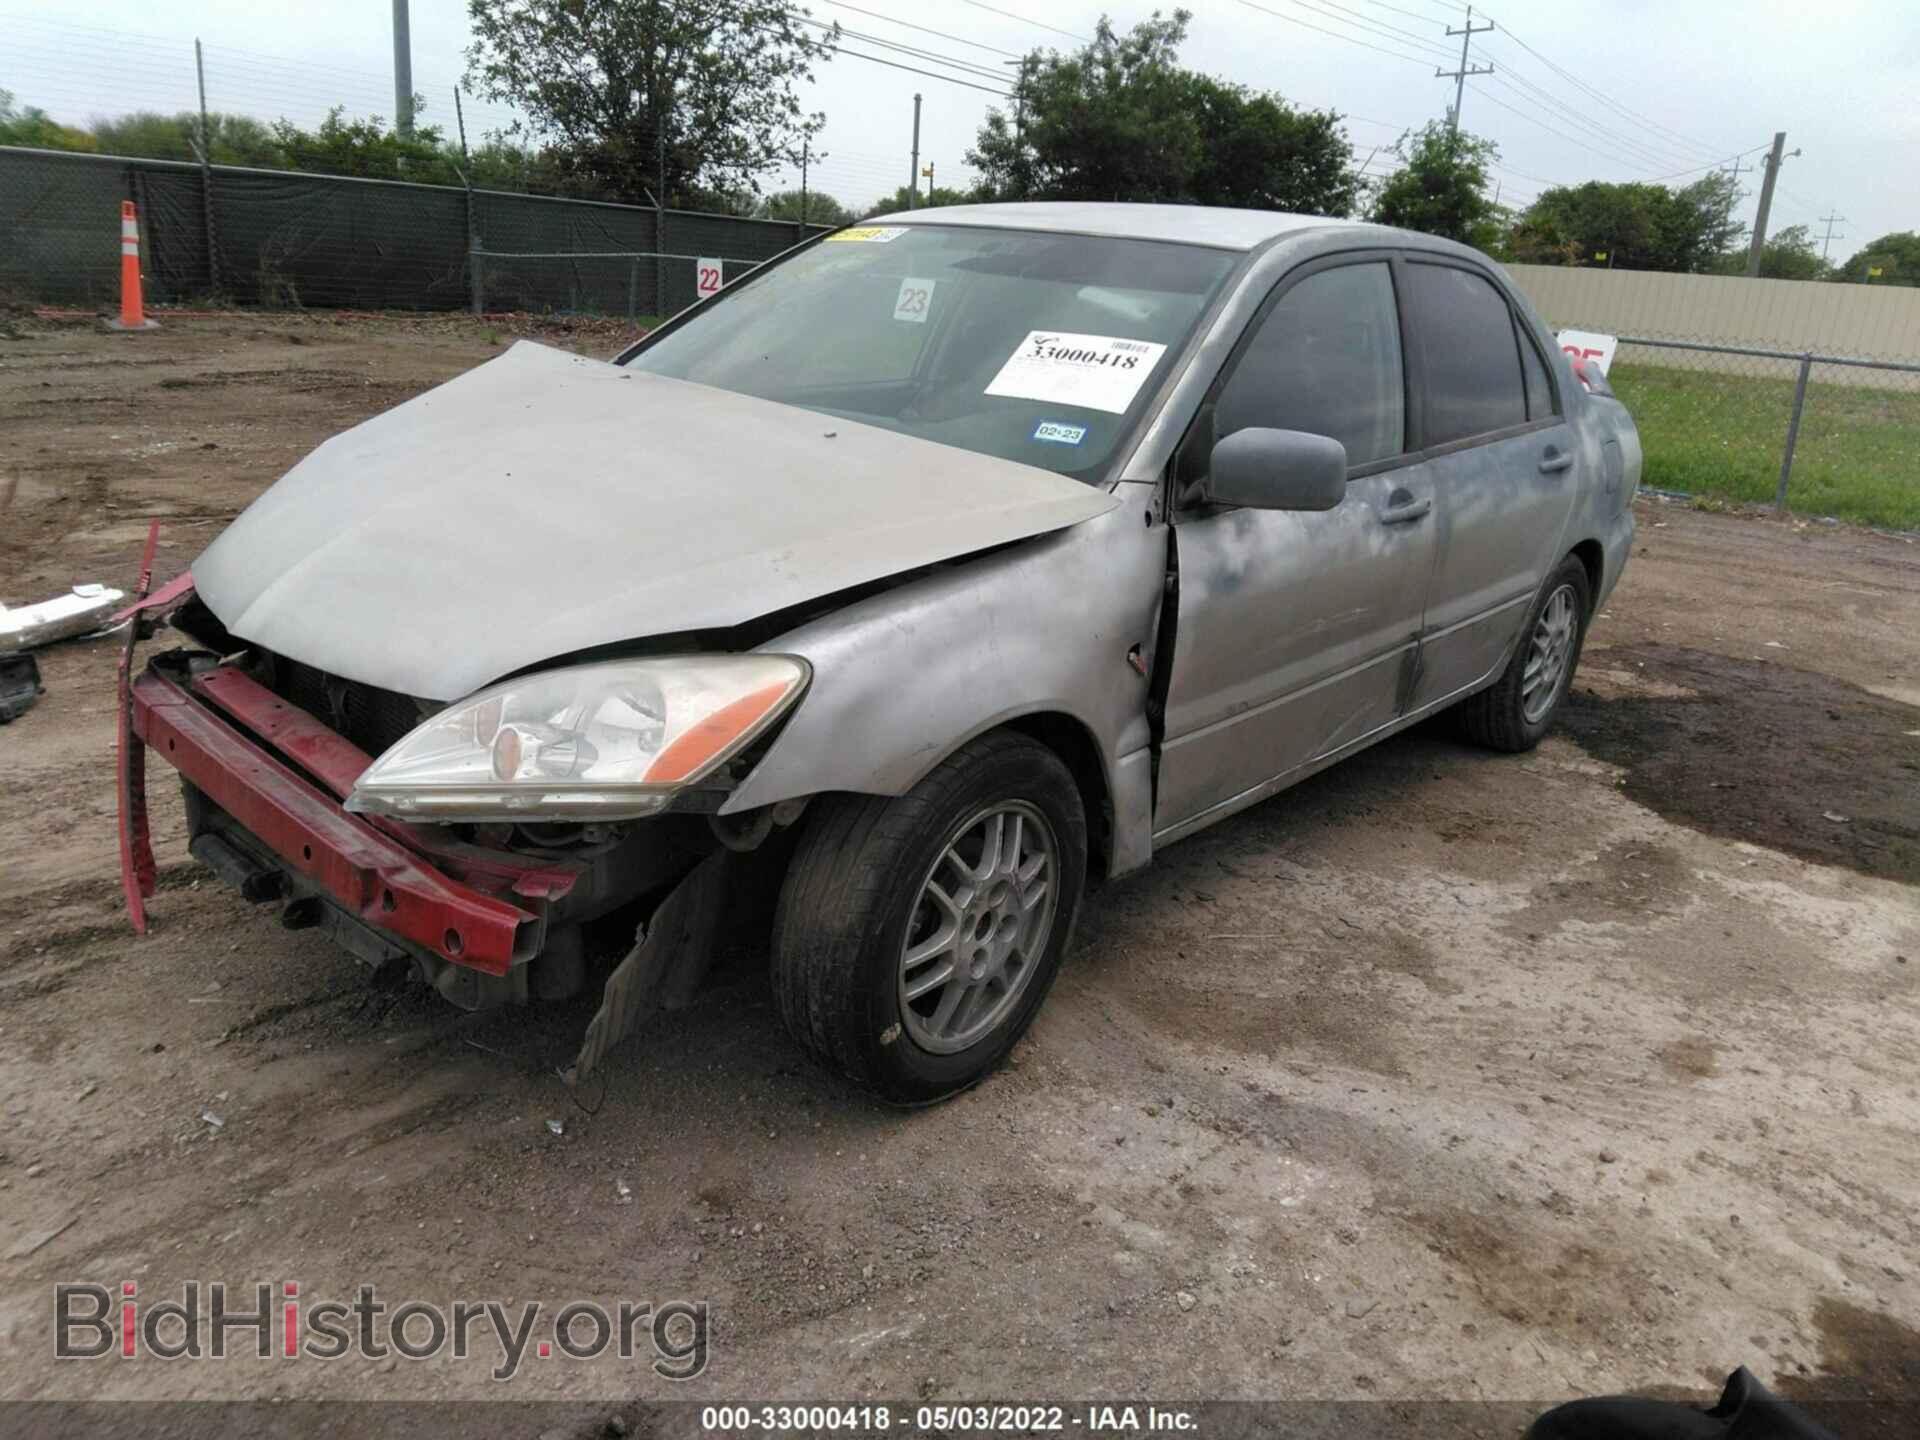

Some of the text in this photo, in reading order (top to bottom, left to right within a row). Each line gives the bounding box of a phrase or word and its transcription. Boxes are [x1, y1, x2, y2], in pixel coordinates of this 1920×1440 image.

[700, 268, 719, 291] 22
[899, 288, 929, 313] 23
[1026, 345, 1139, 370] 33000418
